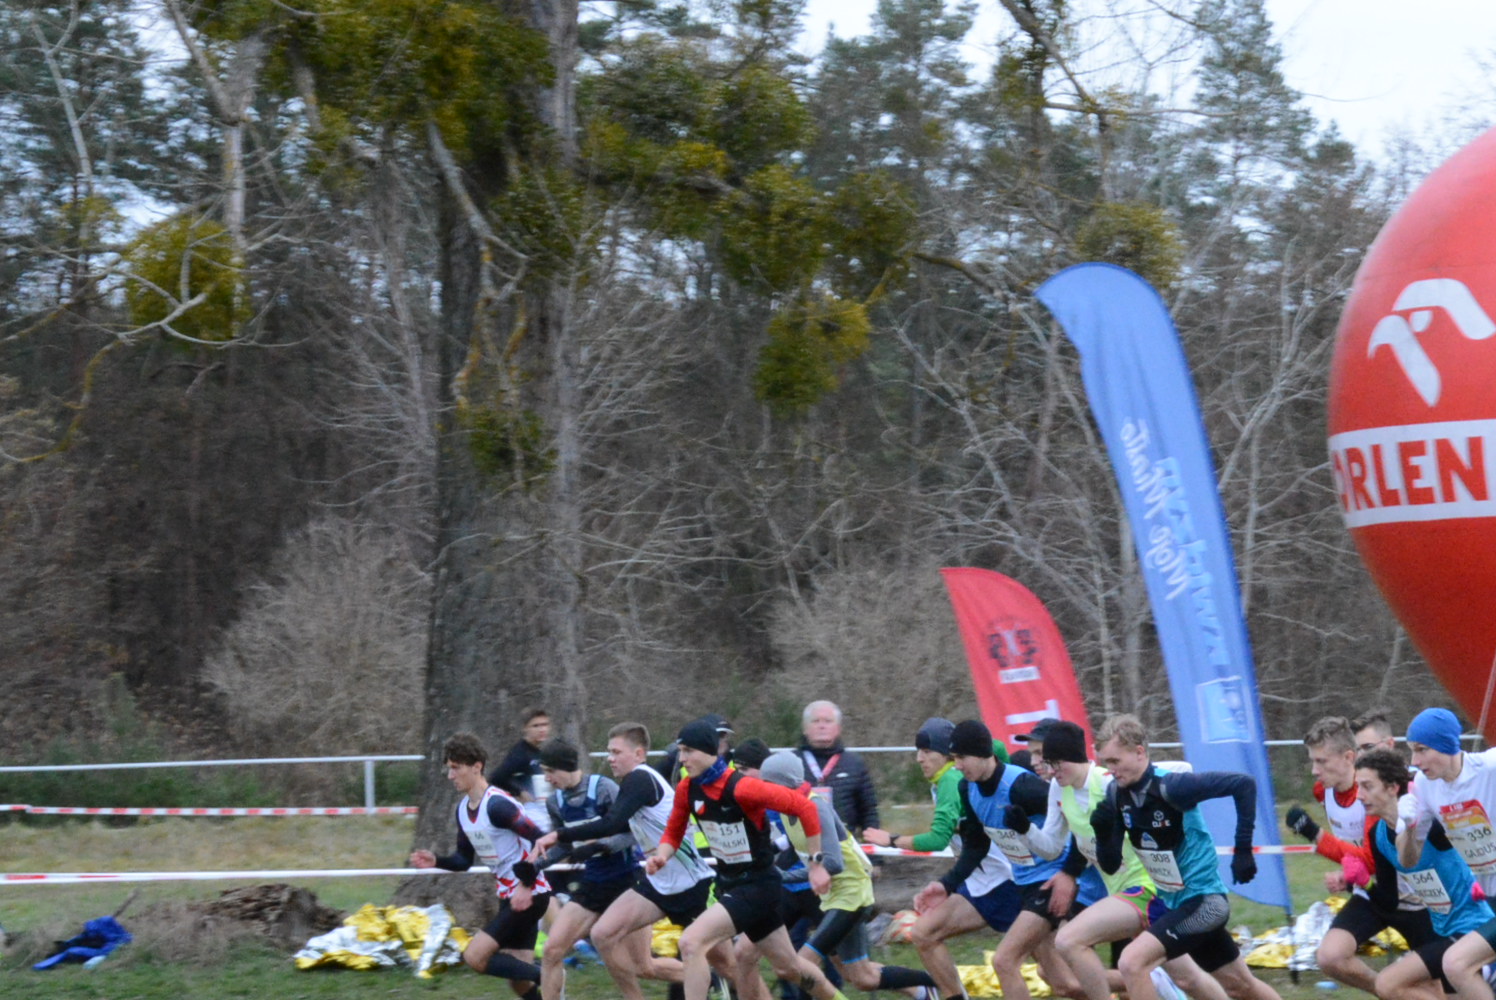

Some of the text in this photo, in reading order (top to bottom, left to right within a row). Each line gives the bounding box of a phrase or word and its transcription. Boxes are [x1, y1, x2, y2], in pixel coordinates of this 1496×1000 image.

[719, 824, 741, 837] 151
[1467, 826, 1493, 843] 336
[1149, 852, 1171, 864] 308
[1411, 872, 1435, 885] 564
